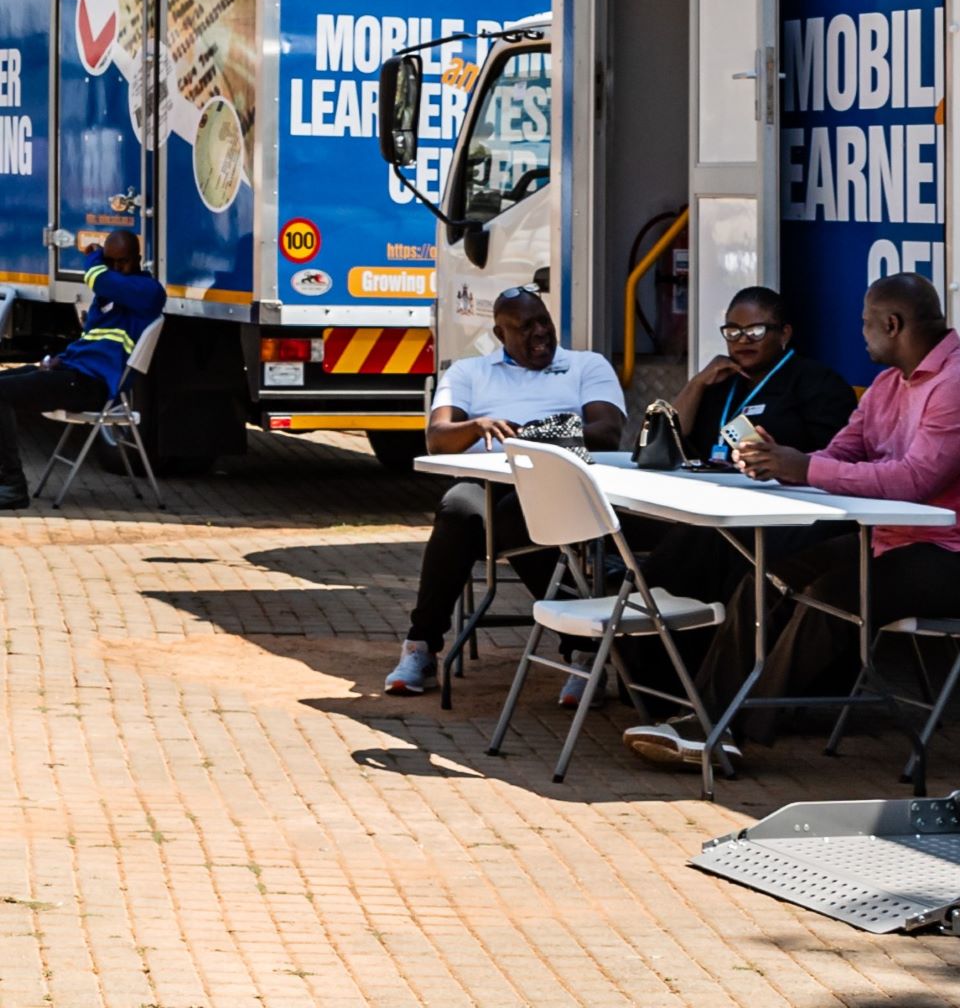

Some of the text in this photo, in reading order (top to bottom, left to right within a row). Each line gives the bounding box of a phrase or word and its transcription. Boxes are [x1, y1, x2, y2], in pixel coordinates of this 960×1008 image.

[315, 13, 465, 75] MOBILE
[290, 78, 469, 140] LEARER
[286, 231, 315, 250] 100
[362, 271, 426, 295] Growing
